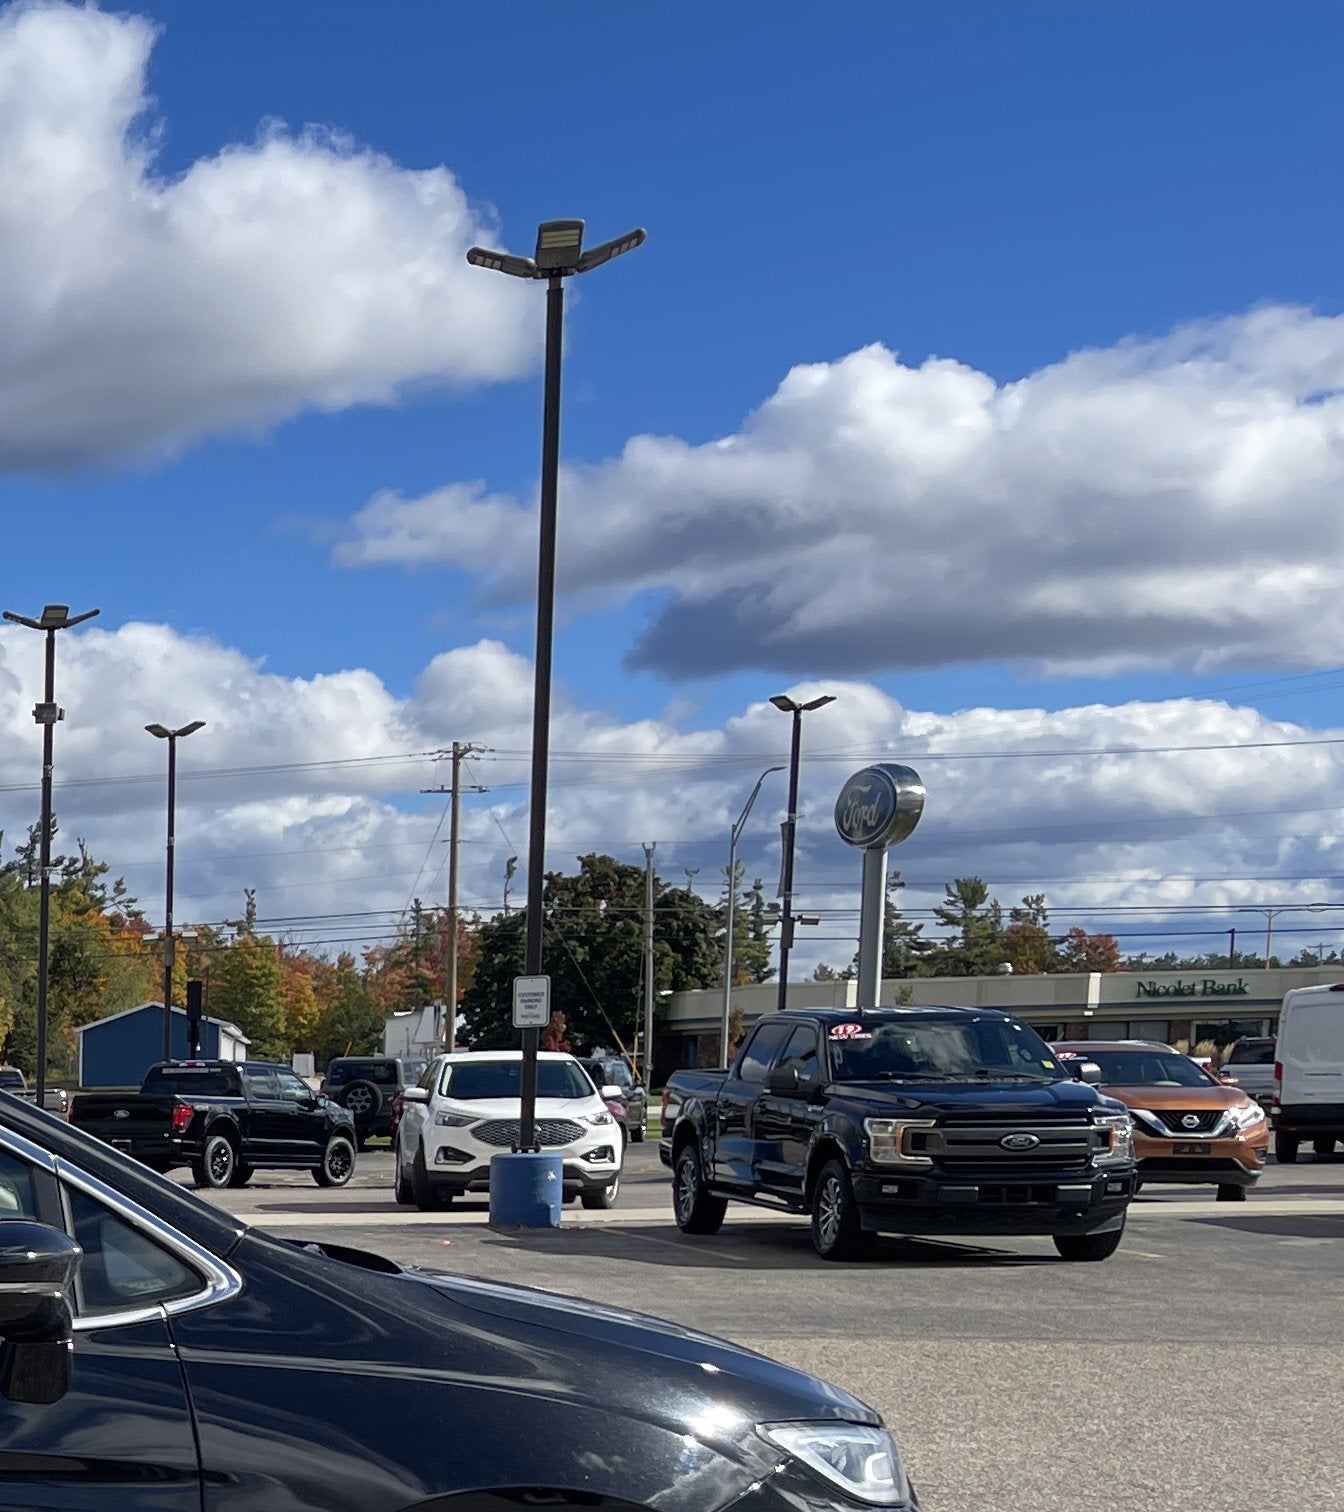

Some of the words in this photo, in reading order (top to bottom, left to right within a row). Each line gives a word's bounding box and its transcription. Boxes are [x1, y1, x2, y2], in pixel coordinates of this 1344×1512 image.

[843, 785, 882, 831] Ford
[1136, 980, 1197, 998] Nicolet
[1201, 978, 1249, 996] Bank
